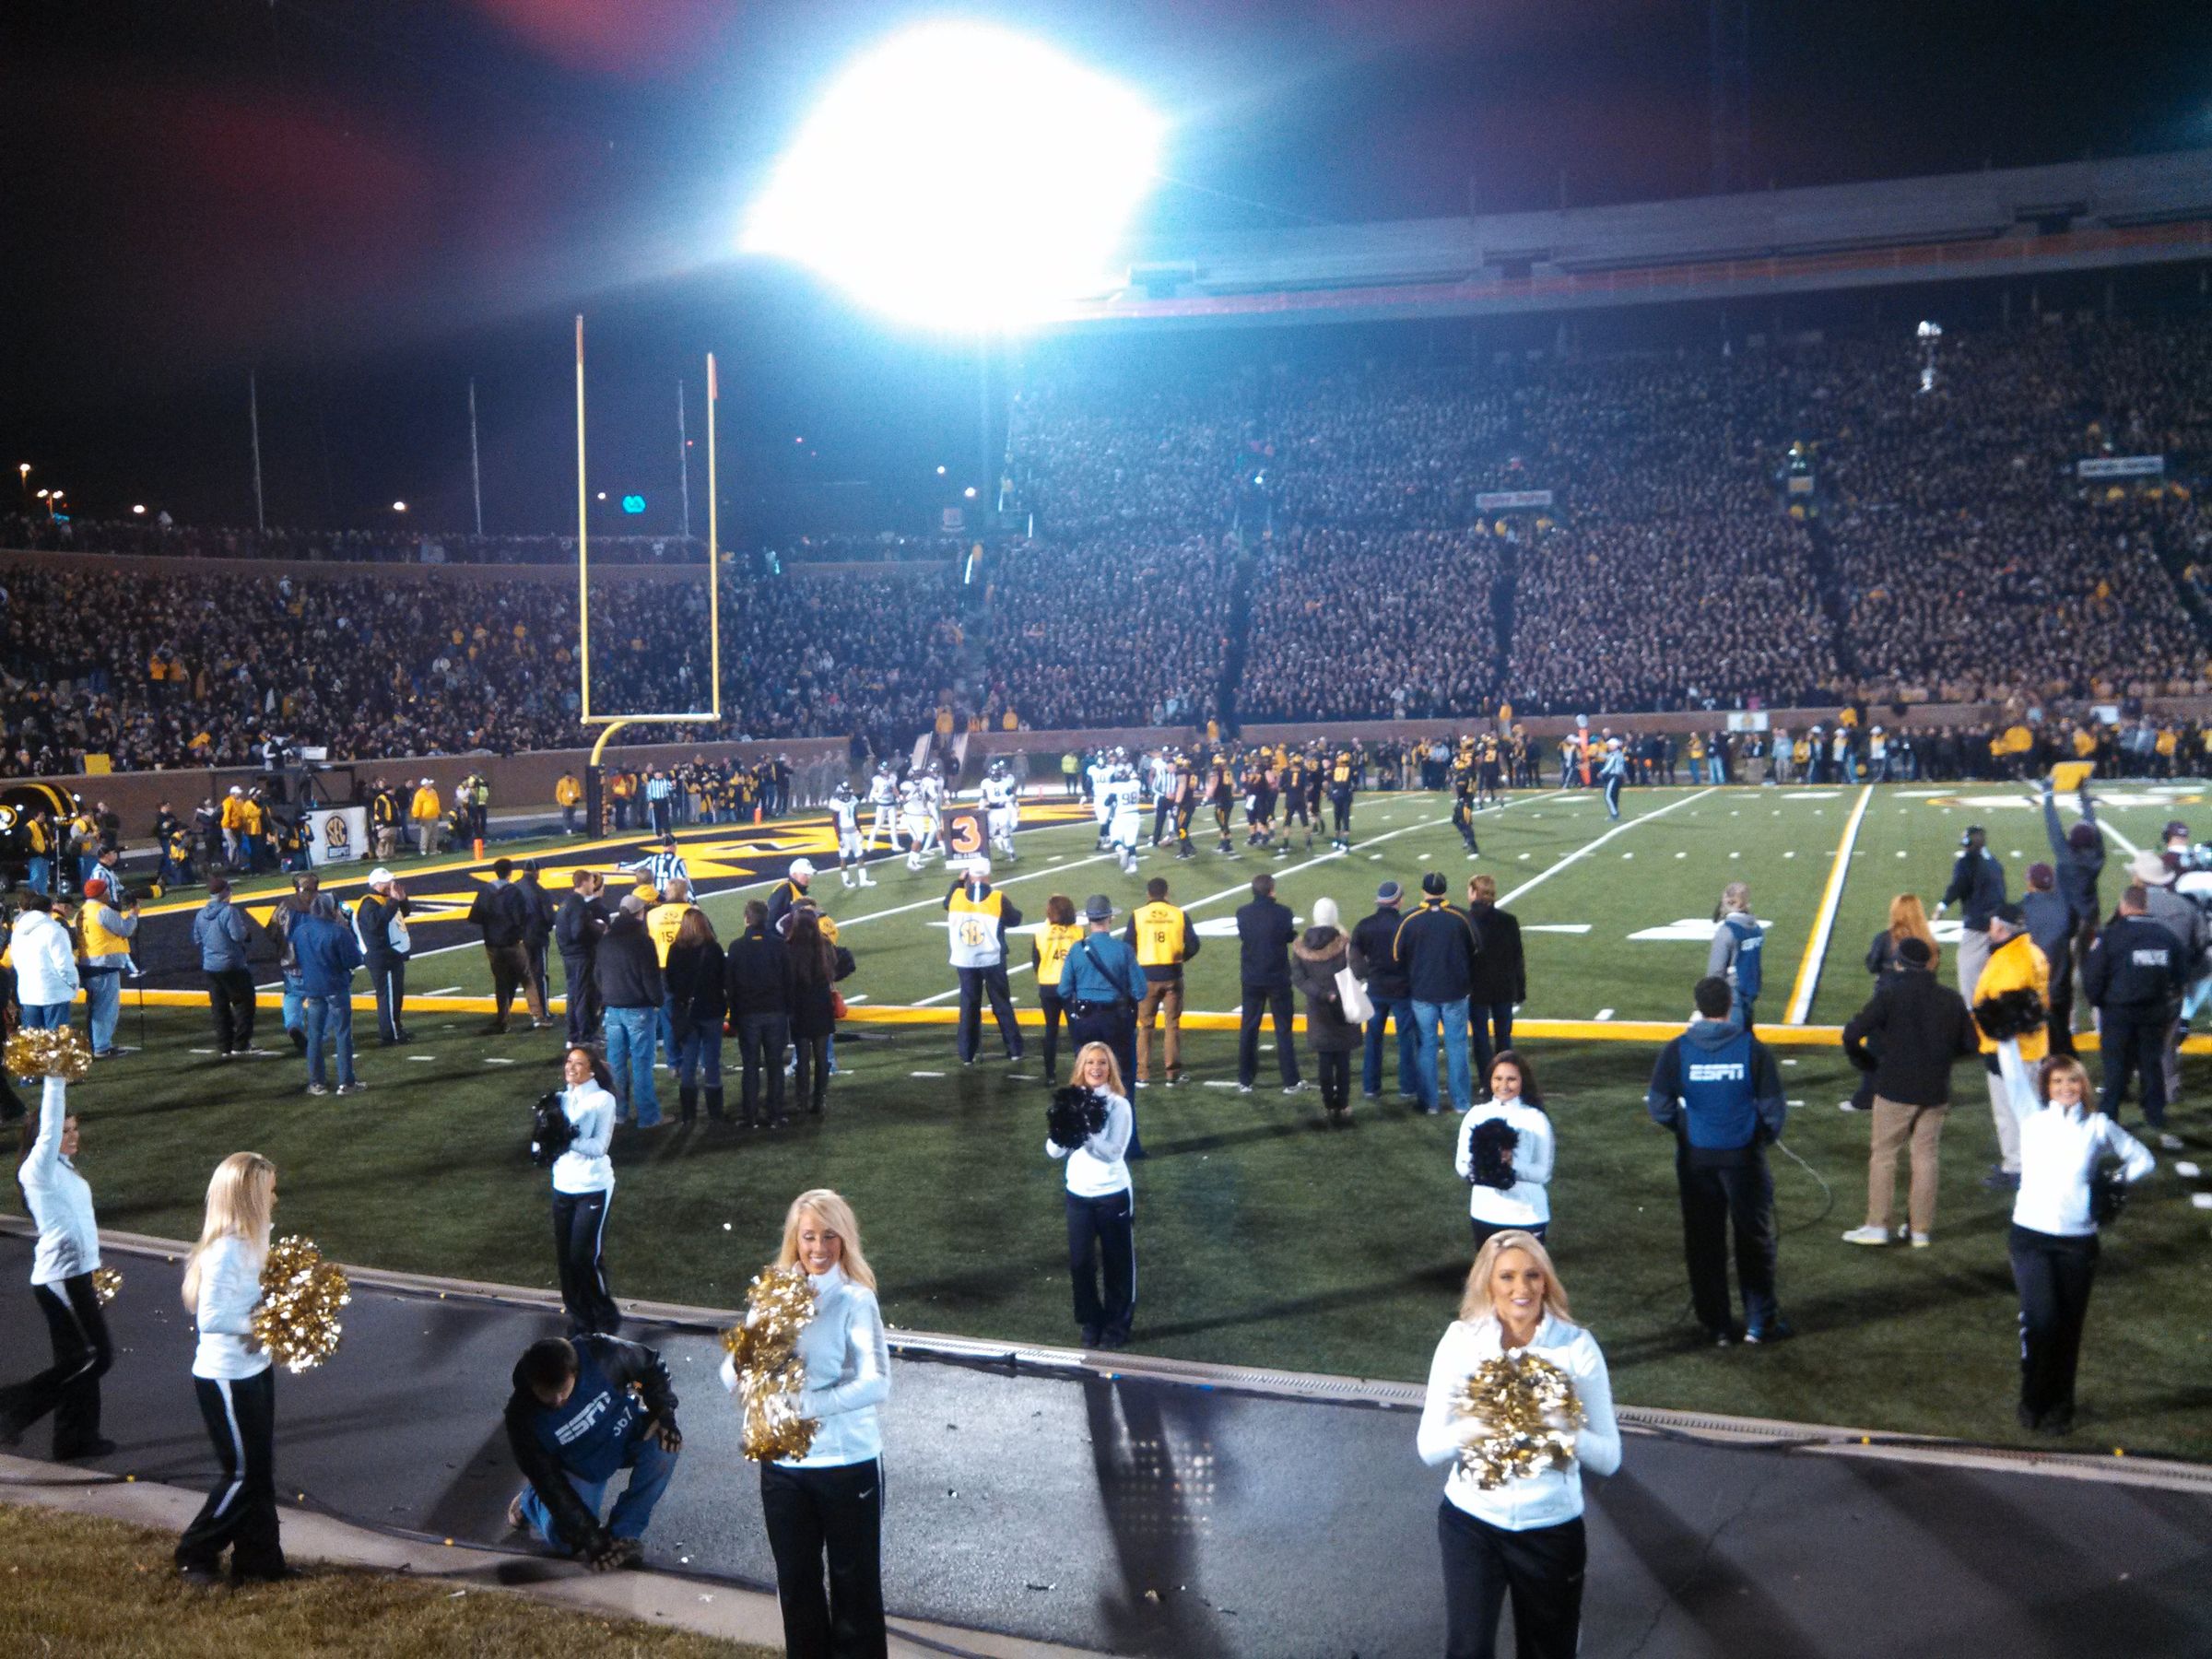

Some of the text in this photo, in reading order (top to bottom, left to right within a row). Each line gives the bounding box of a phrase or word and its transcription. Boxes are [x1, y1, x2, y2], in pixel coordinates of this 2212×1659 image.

[951, 815, 982, 853] 3
[661, 931, 675, 943] 15
[1154, 931, 1166, 944] 18
[1688, 1063, 1745, 1081] ESPN
[554, 1390, 612, 1446] ESPN
